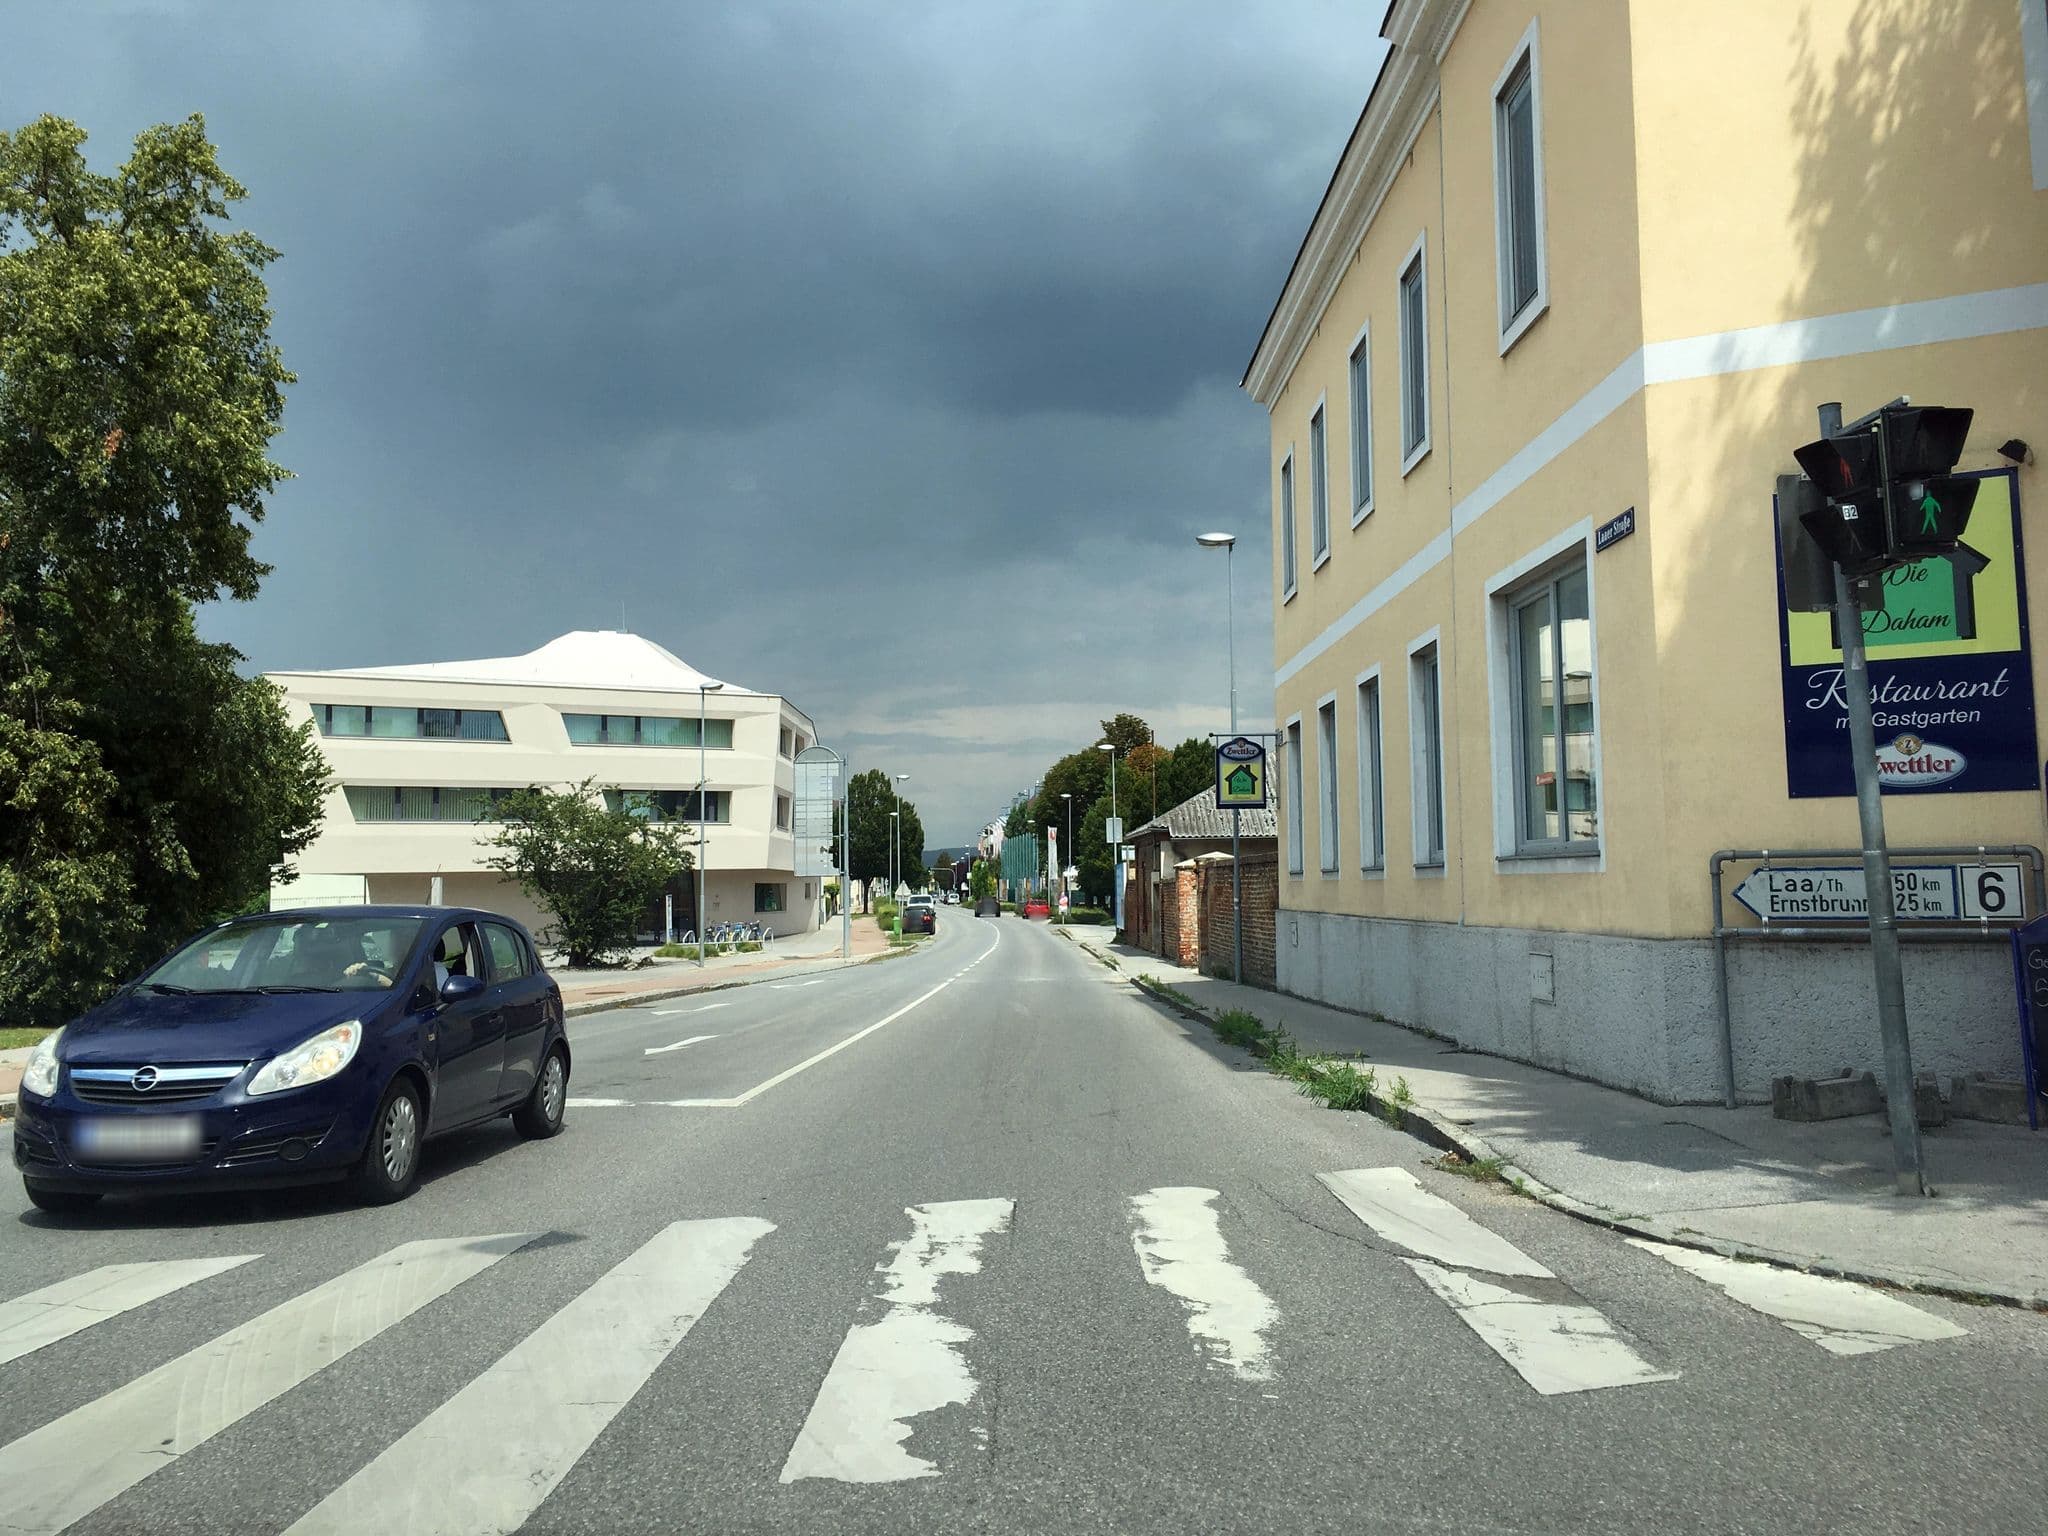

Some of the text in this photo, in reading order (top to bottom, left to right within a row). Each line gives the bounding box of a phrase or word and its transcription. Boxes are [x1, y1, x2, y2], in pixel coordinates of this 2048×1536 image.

[1861, 608, 1951, 634] Daham
[1805, 667, 2010, 710] Rstaurant
[1871, 709, 1981, 729] Gastgarten
[1895, 872, 1917, 891] 50
[1922, 877, 1941, 891] km
[1977, 871, 2006, 913] 6
[1896, 893, 1919, 912] 25
[1923, 898, 1942, 912] km
